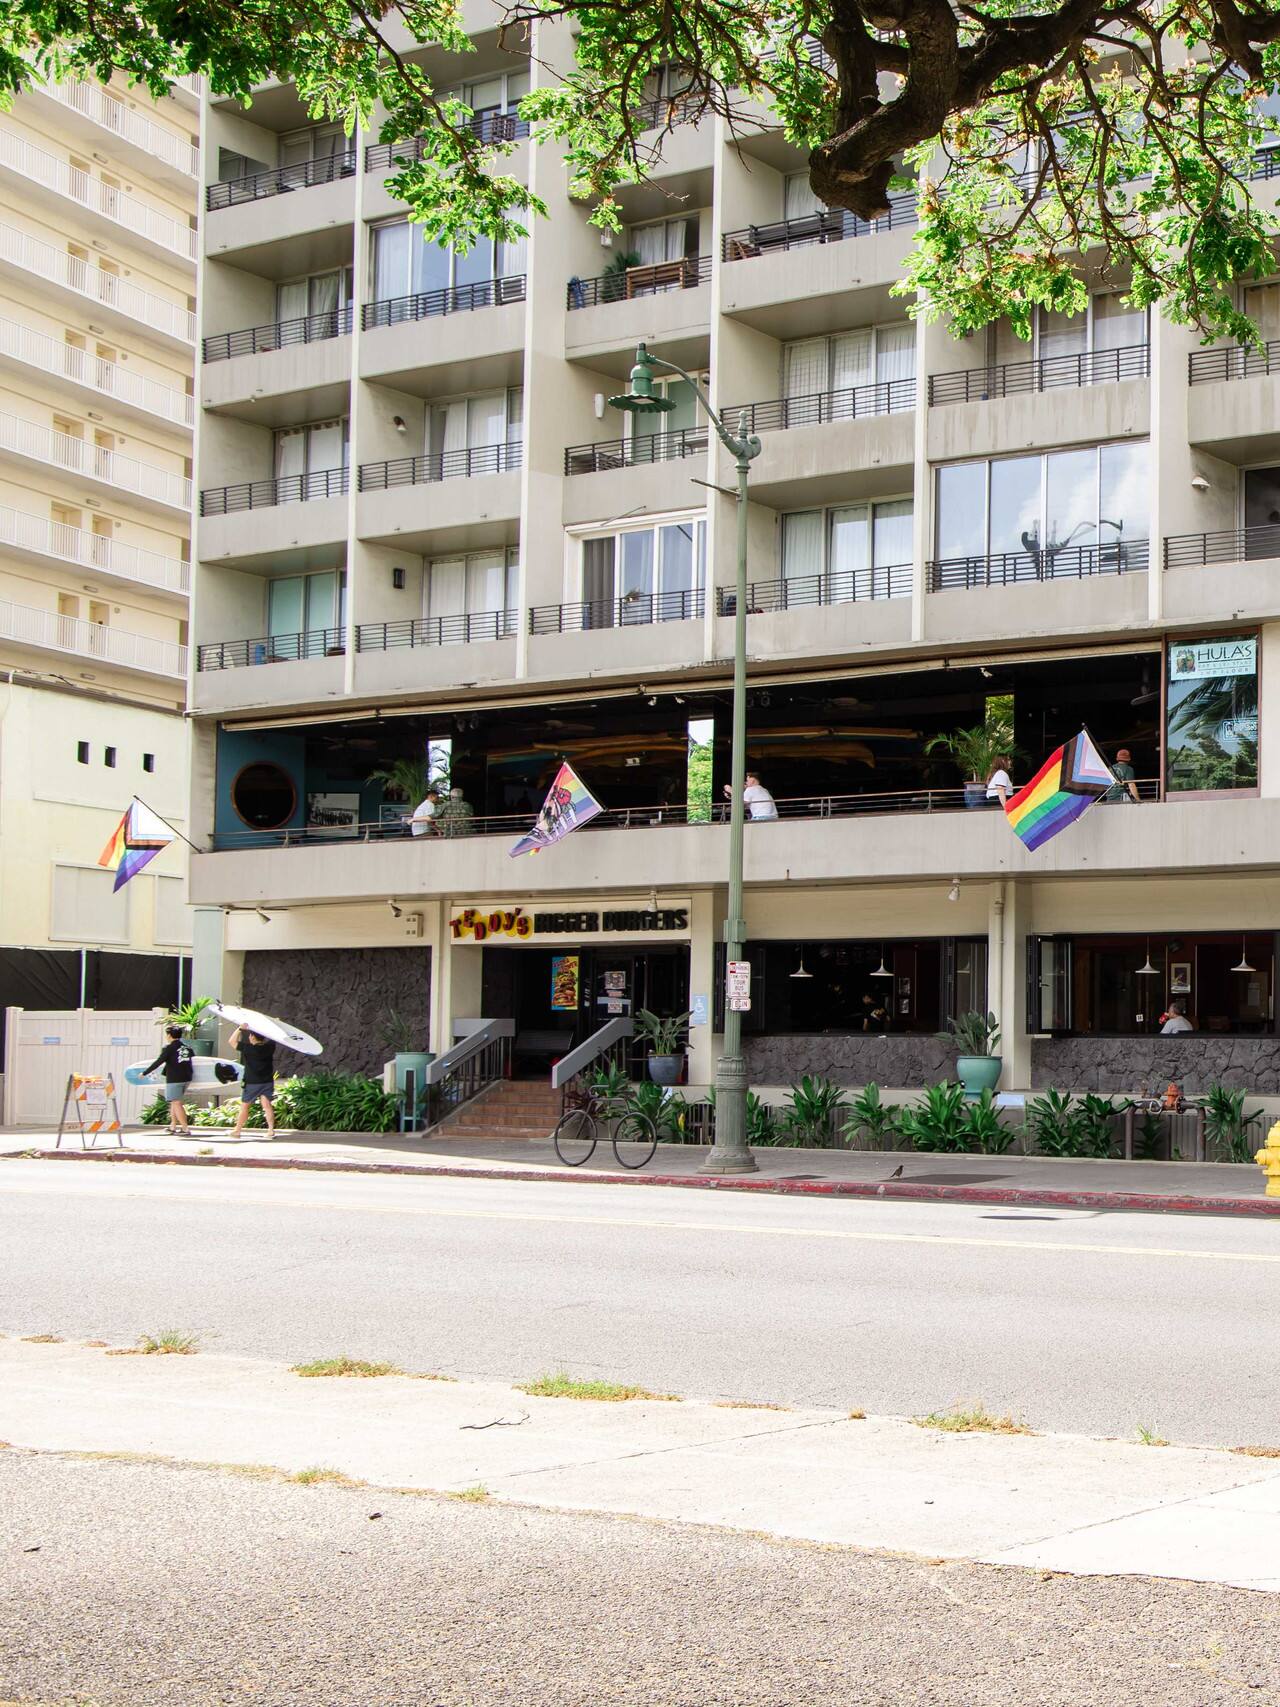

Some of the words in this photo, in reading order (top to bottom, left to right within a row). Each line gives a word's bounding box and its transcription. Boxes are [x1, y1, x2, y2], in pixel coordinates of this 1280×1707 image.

[1198, 645, 1252, 660] HULA'S
[534, 911, 599, 934] BIGGER
[602, 908, 689, 932] BURGERS
